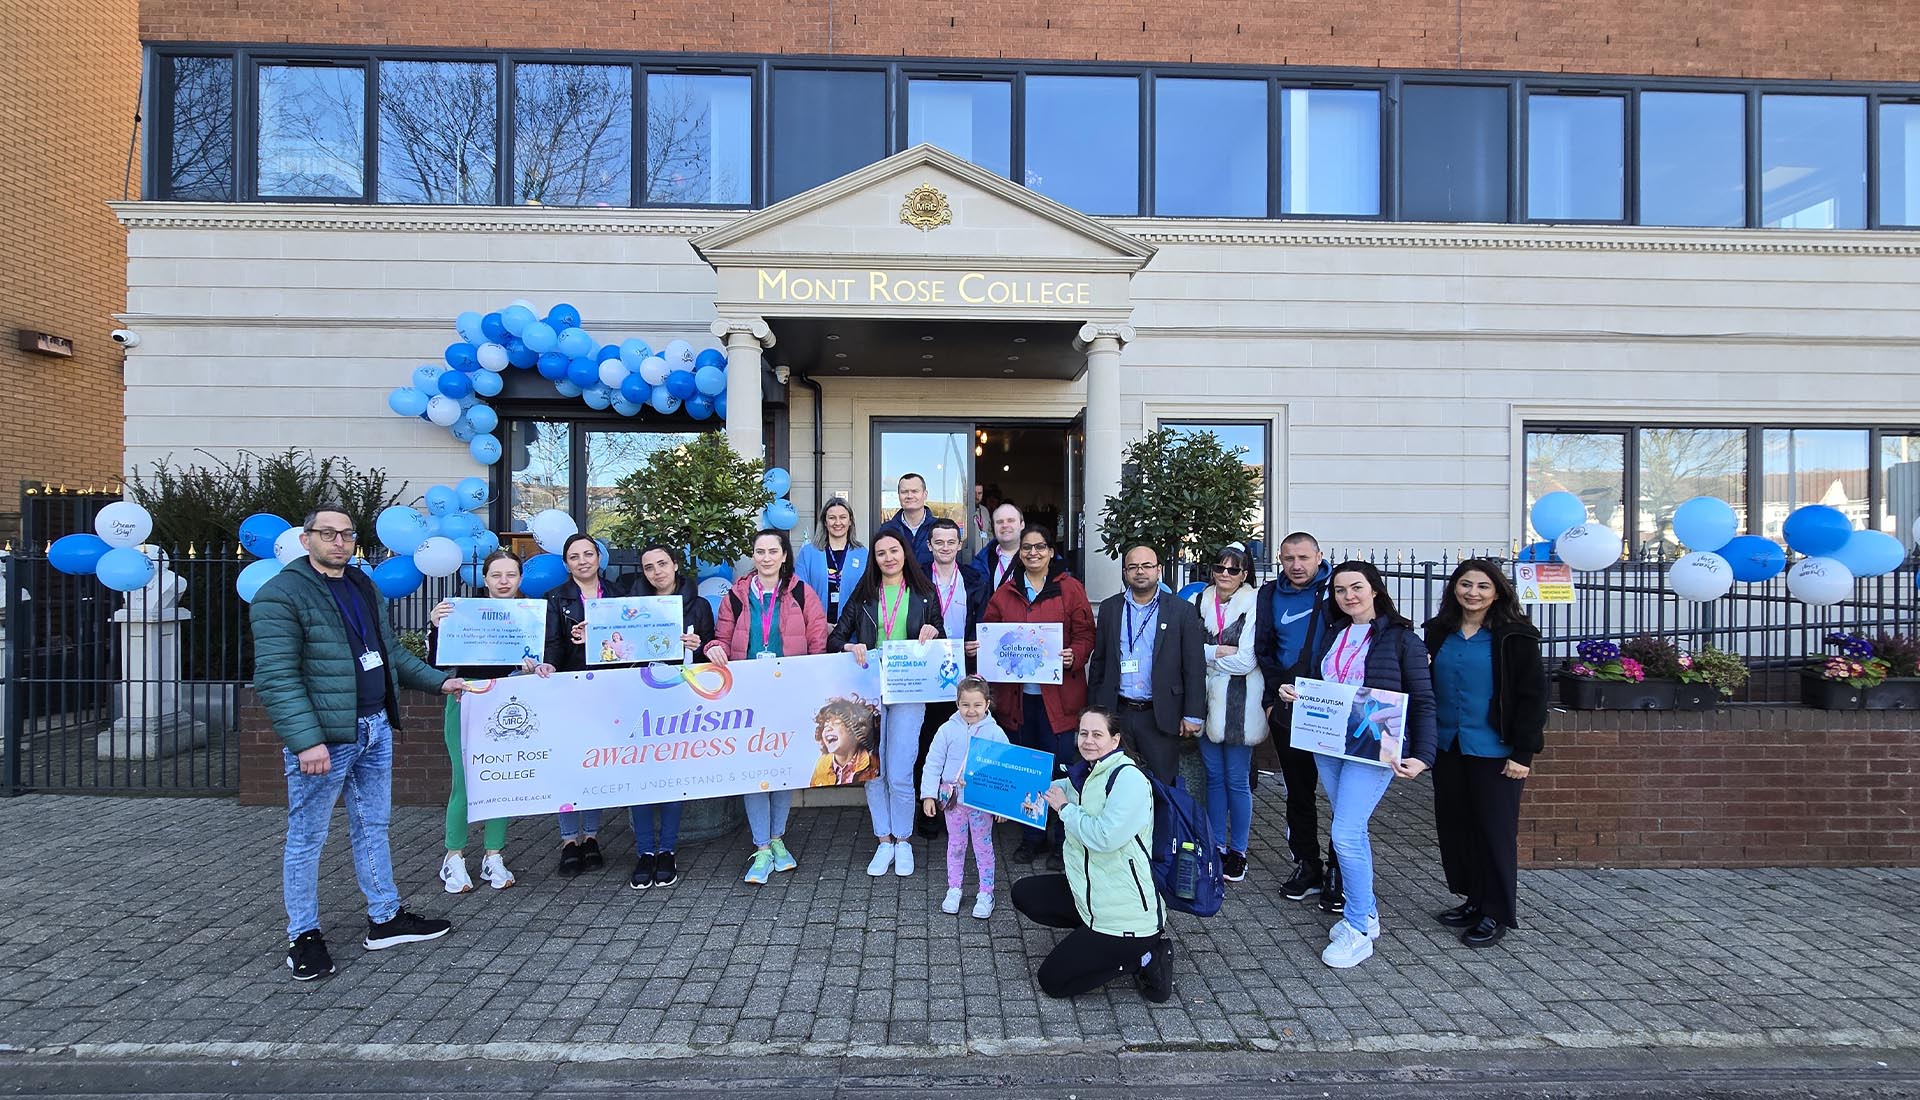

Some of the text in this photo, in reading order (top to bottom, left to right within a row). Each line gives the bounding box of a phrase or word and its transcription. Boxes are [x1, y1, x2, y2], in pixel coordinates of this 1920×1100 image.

[916, 203, 937, 211] MRC
[757, 268, 1090, 304] MONT ROSE COLLEGE
[112, 520, 136, 528] Dream
[113, 528, 133, 537] Big!
[1692, 562, 1720, 574] Dream
[482, 611, 511, 621] AUTISM
[1001, 644, 1038, 652] Celebrate
[887, 660, 928, 668] AUTISM DAY
[1298, 694, 1344, 707] WORLD AUTISM
[502, 717, 523, 726] MRC
[629, 705, 754, 739] Autism
[582, 727, 796, 769] awareness day
[472, 753, 513, 765] MONT
[976, 756, 1042, 775] CELEBRATE NEURODIVERSITY
[479, 769, 536, 781] COLLEGE
[640, 775, 723, 791] UNDERSTAND
[729, 773, 736, 781] &
[741, 767, 793, 780] SUPPORT
